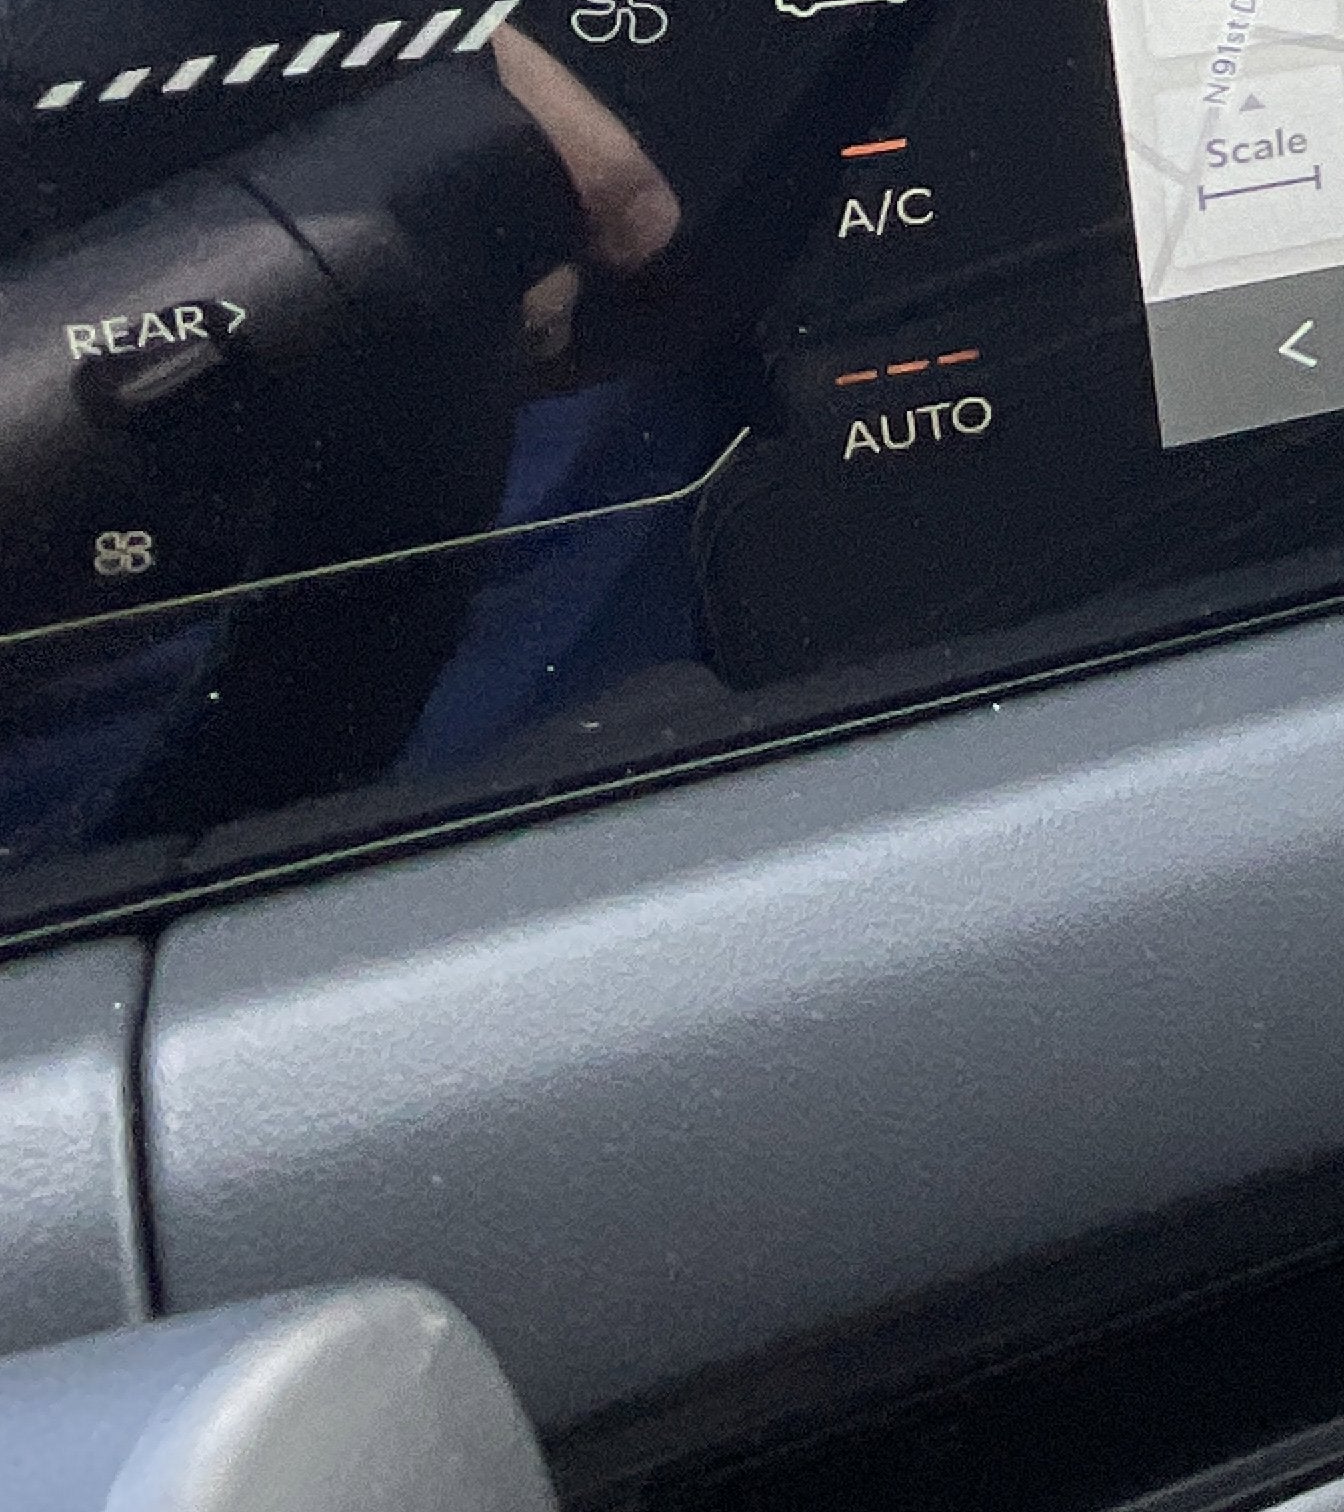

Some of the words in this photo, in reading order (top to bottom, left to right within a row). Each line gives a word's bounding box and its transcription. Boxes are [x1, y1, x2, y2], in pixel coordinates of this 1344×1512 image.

[1211, 19, 1251, 76] 91st
[1203, 82, 1231, 106] N
[1206, 126, 1308, 169] Scale
[837, 187, 935, 240] A/C
[66, 303, 210, 361] REAR
[842, 395, 993, 461] AUTO
